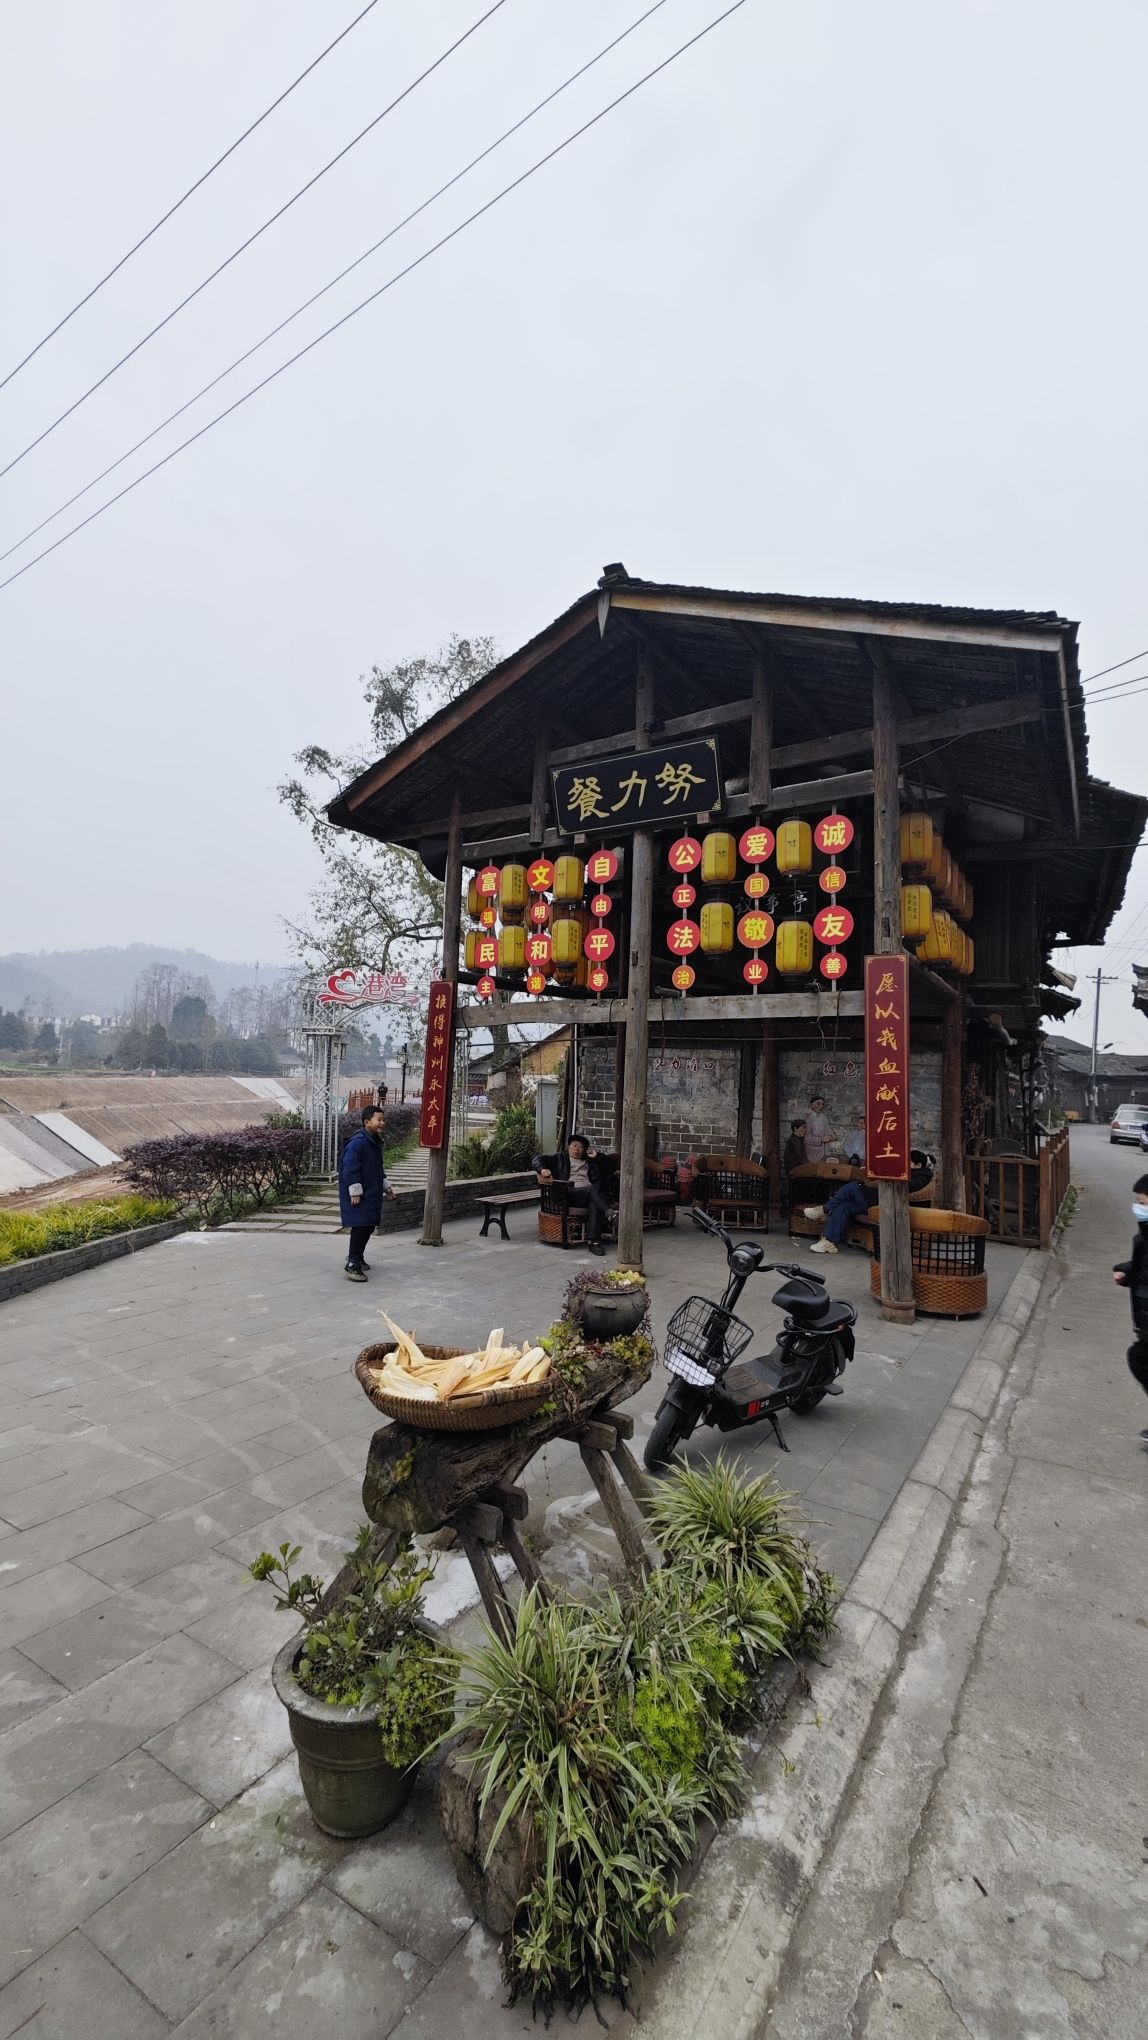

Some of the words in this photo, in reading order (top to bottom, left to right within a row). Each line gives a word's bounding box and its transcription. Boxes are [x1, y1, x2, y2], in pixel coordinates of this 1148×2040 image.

[567, 761, 707, 822] 努力餐
[480, 872, 497, 993] 富强民主
[531, 865, 550, 990] 文明和谐
[590, 857, 610, 986] 自由平等
[673, 844, 696, 985] 公正法治
[744, 833, 768, 979] 爱国敬业
[821, 822, 846, 974] 诚信友善
[361, 971, 408, 999] 港湾
[427, 994, 447, 1135] 换得神州永太平
[875, 972, 900, 1158] 愿以我血献后土
